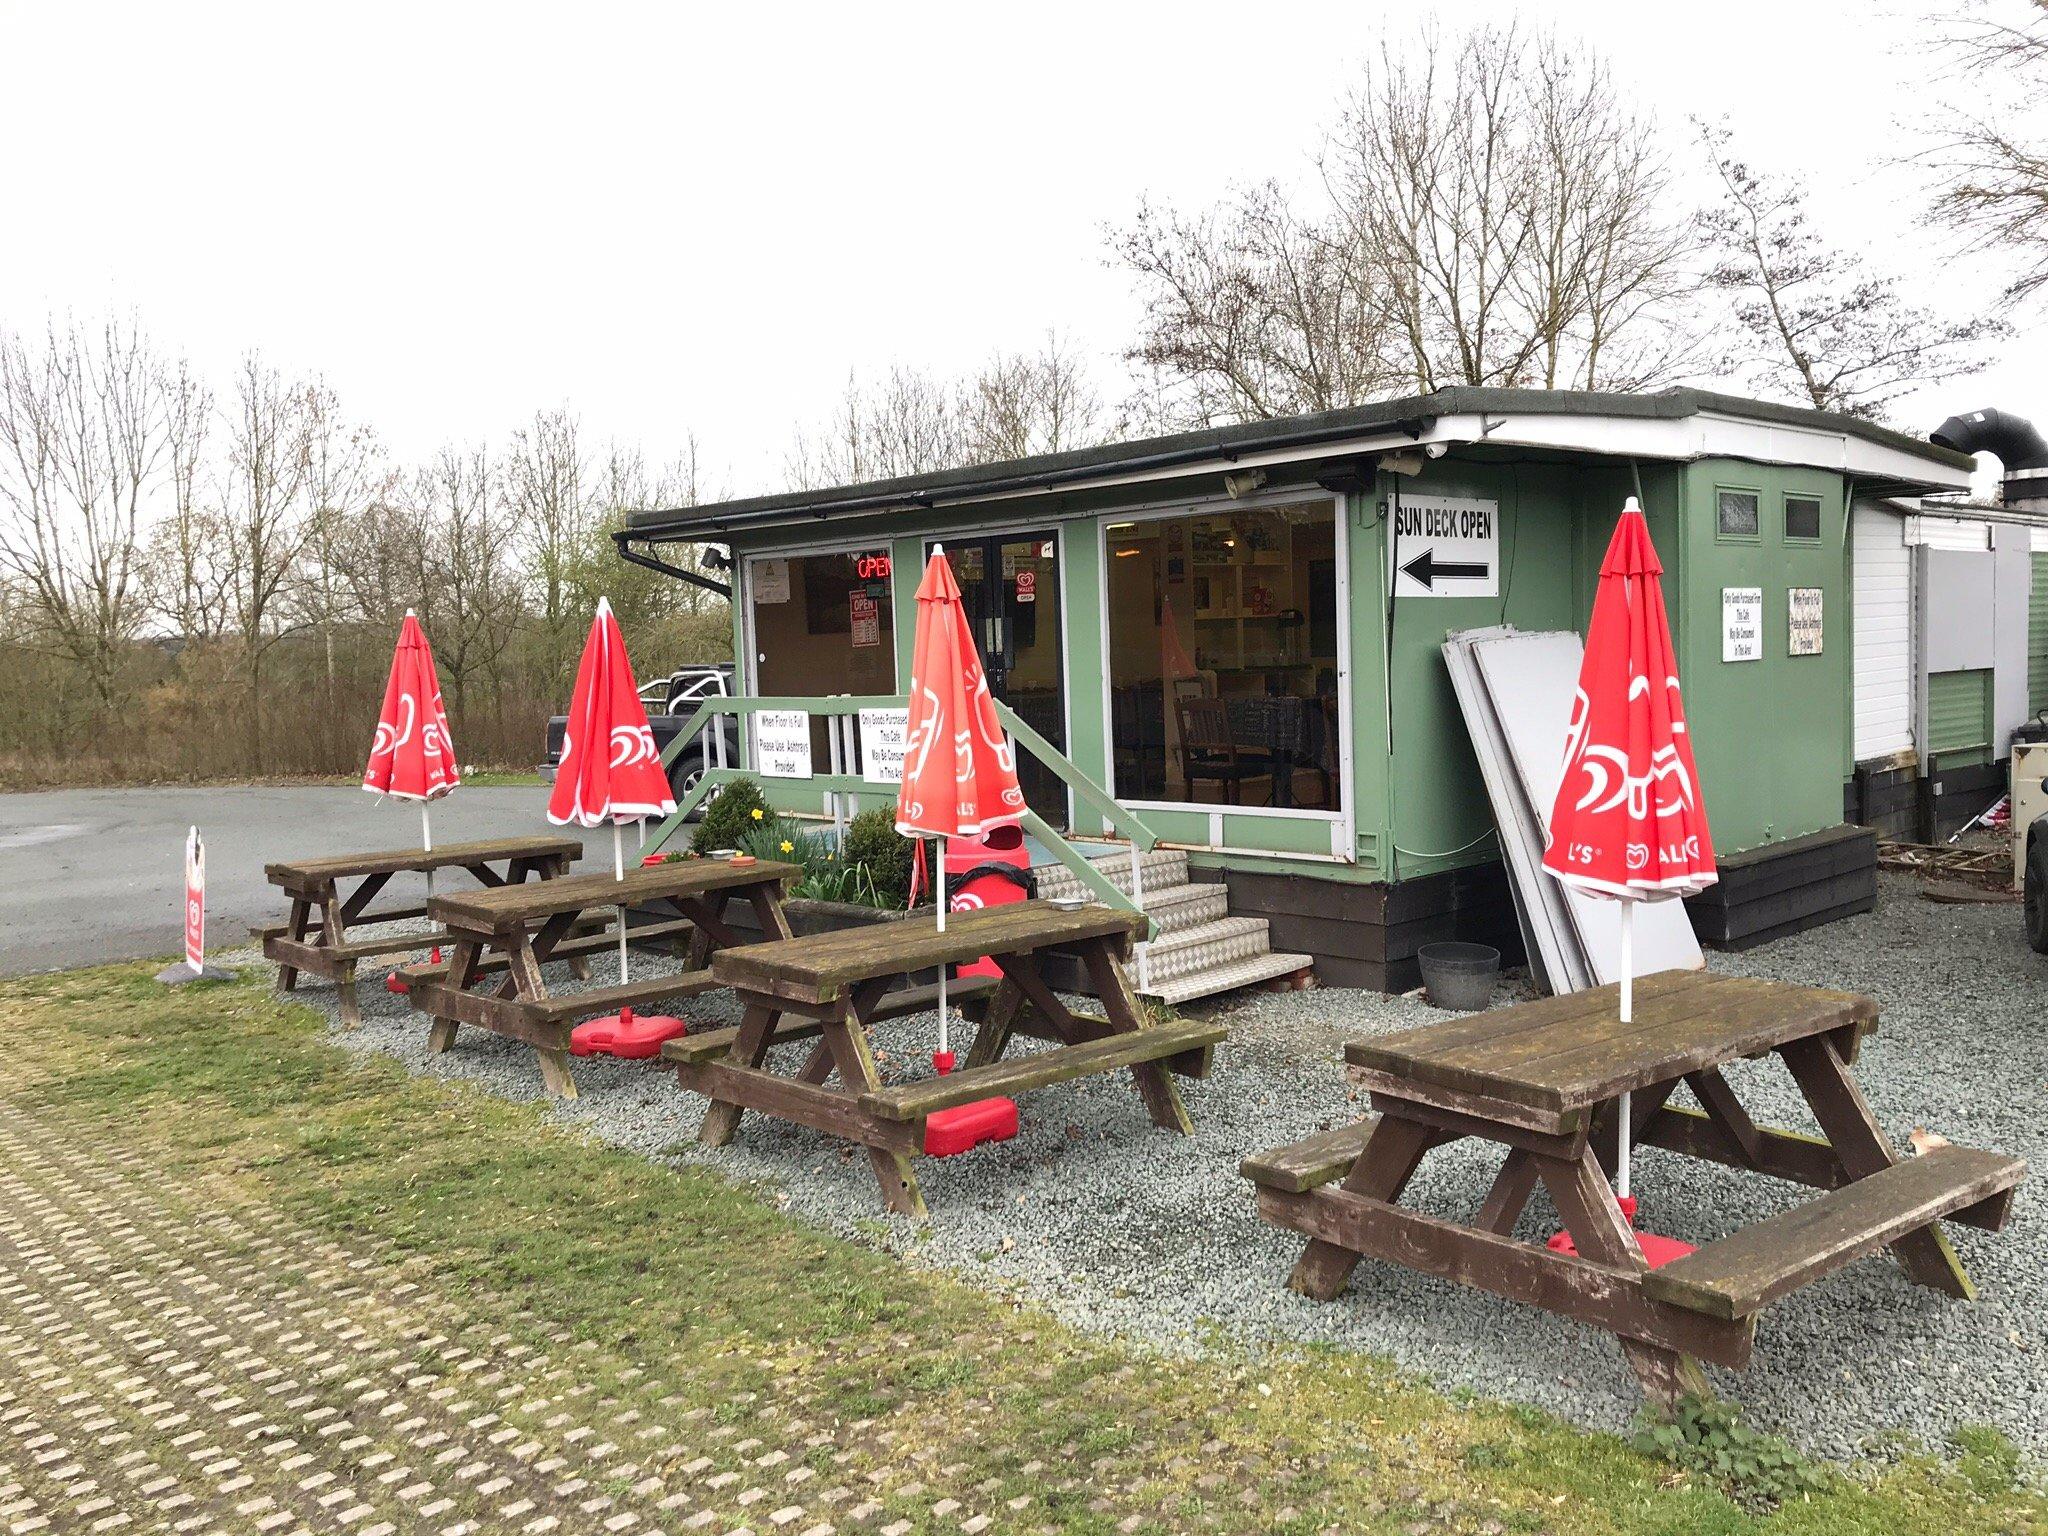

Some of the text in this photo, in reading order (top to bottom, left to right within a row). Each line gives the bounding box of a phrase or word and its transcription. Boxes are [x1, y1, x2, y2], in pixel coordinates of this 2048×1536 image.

[1396, 506, 1491, 539] SUN DECK OPEN
[858, 557, 892, 578] OPEN
[1732, 592, 1740, 604] Goods
[1740, 592, 1754, 604] Purchased
[854, 599, 874, 611] OPEN
[762, 715, 774, 728] When
[775, 715, 788, 728] Floor
[794, 715, 803, 728] Full
[861, 714, 908, 728] Only Goods Purchased
[880, 730, 901, 741] This Cafe
[759, 739, 808, 756] Please Use Ashtrays
[872, 749, 905, 763] May Be Consum
[775, 760, 796, 773] Provided
[879, 767, 903, 778] In This Are
